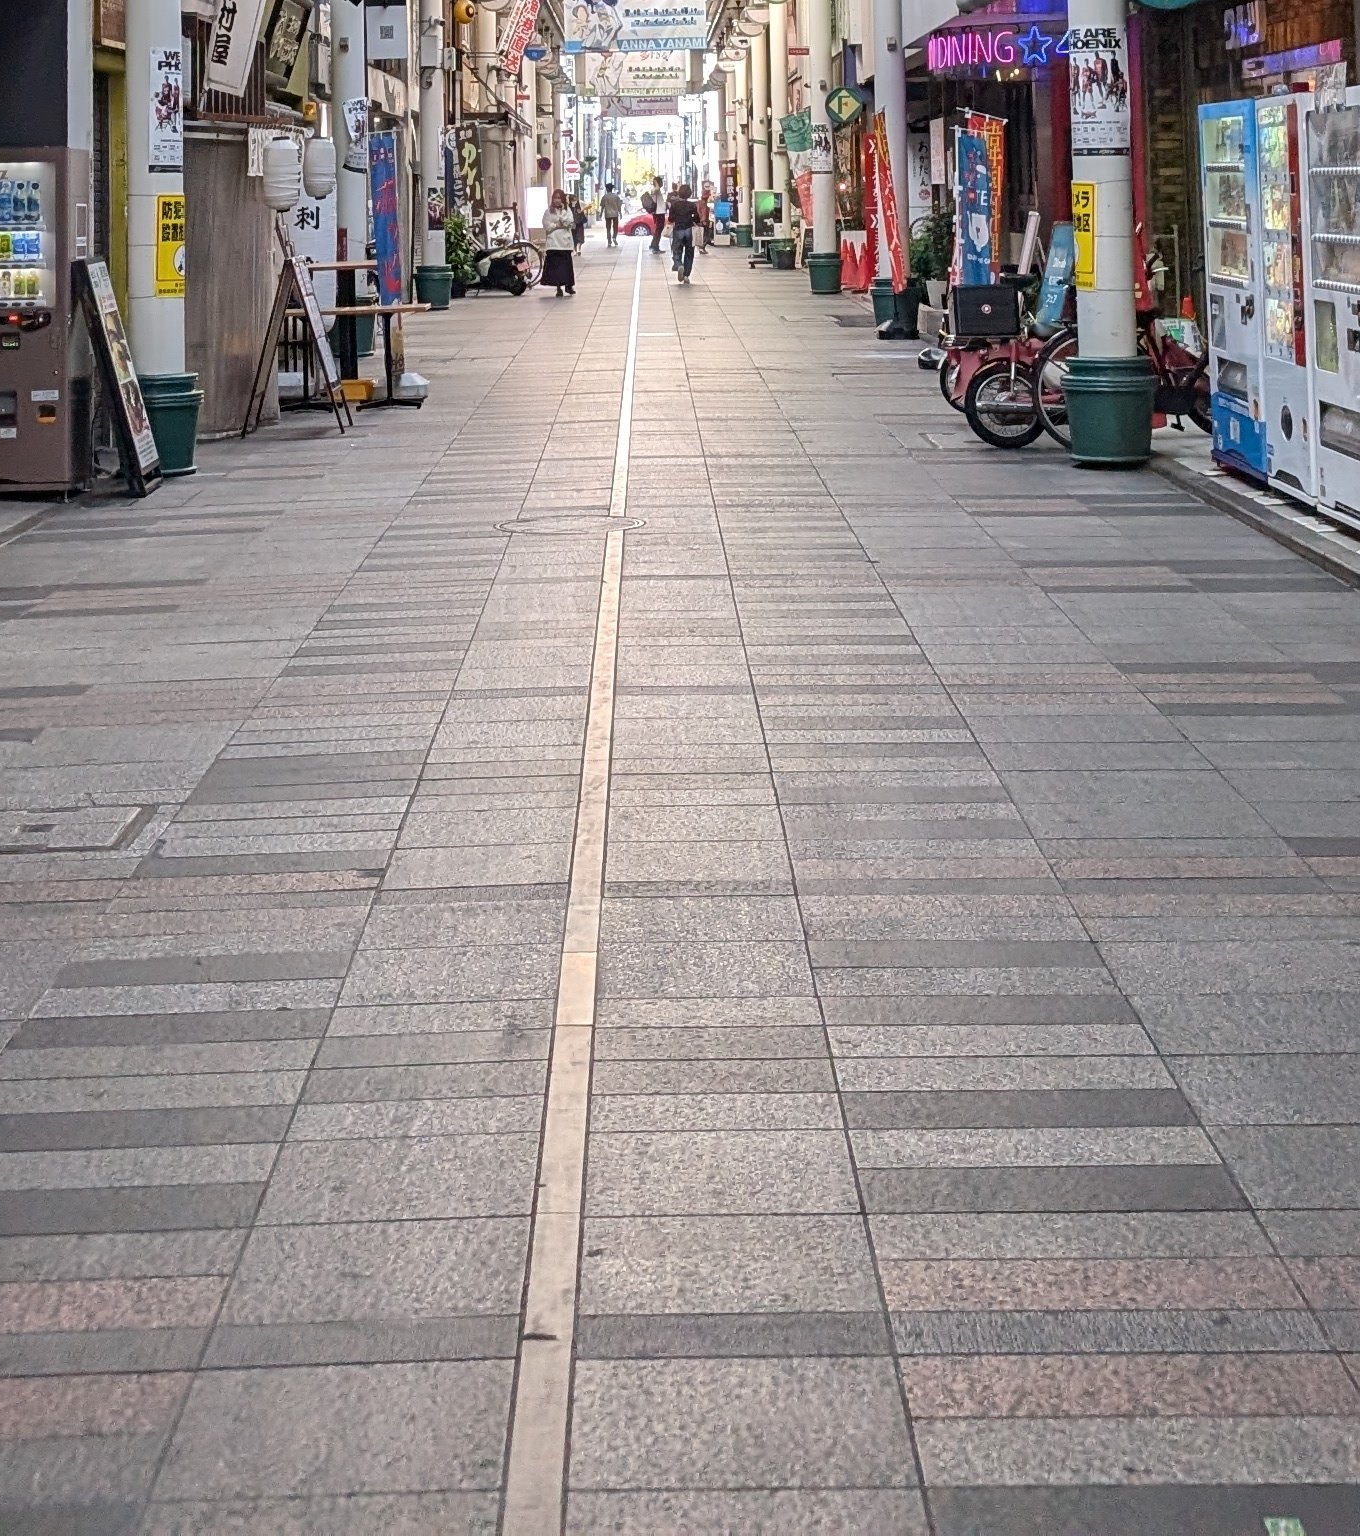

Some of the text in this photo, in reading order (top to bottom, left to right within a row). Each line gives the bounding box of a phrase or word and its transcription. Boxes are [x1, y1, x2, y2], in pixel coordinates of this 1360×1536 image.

[1084, 27, 1117, 39] ARE
[621, 37, 707, 50] ANNA YANAMI
[163, 50, 181, 61] WE
[937, 31, 1014, 70] DINING
